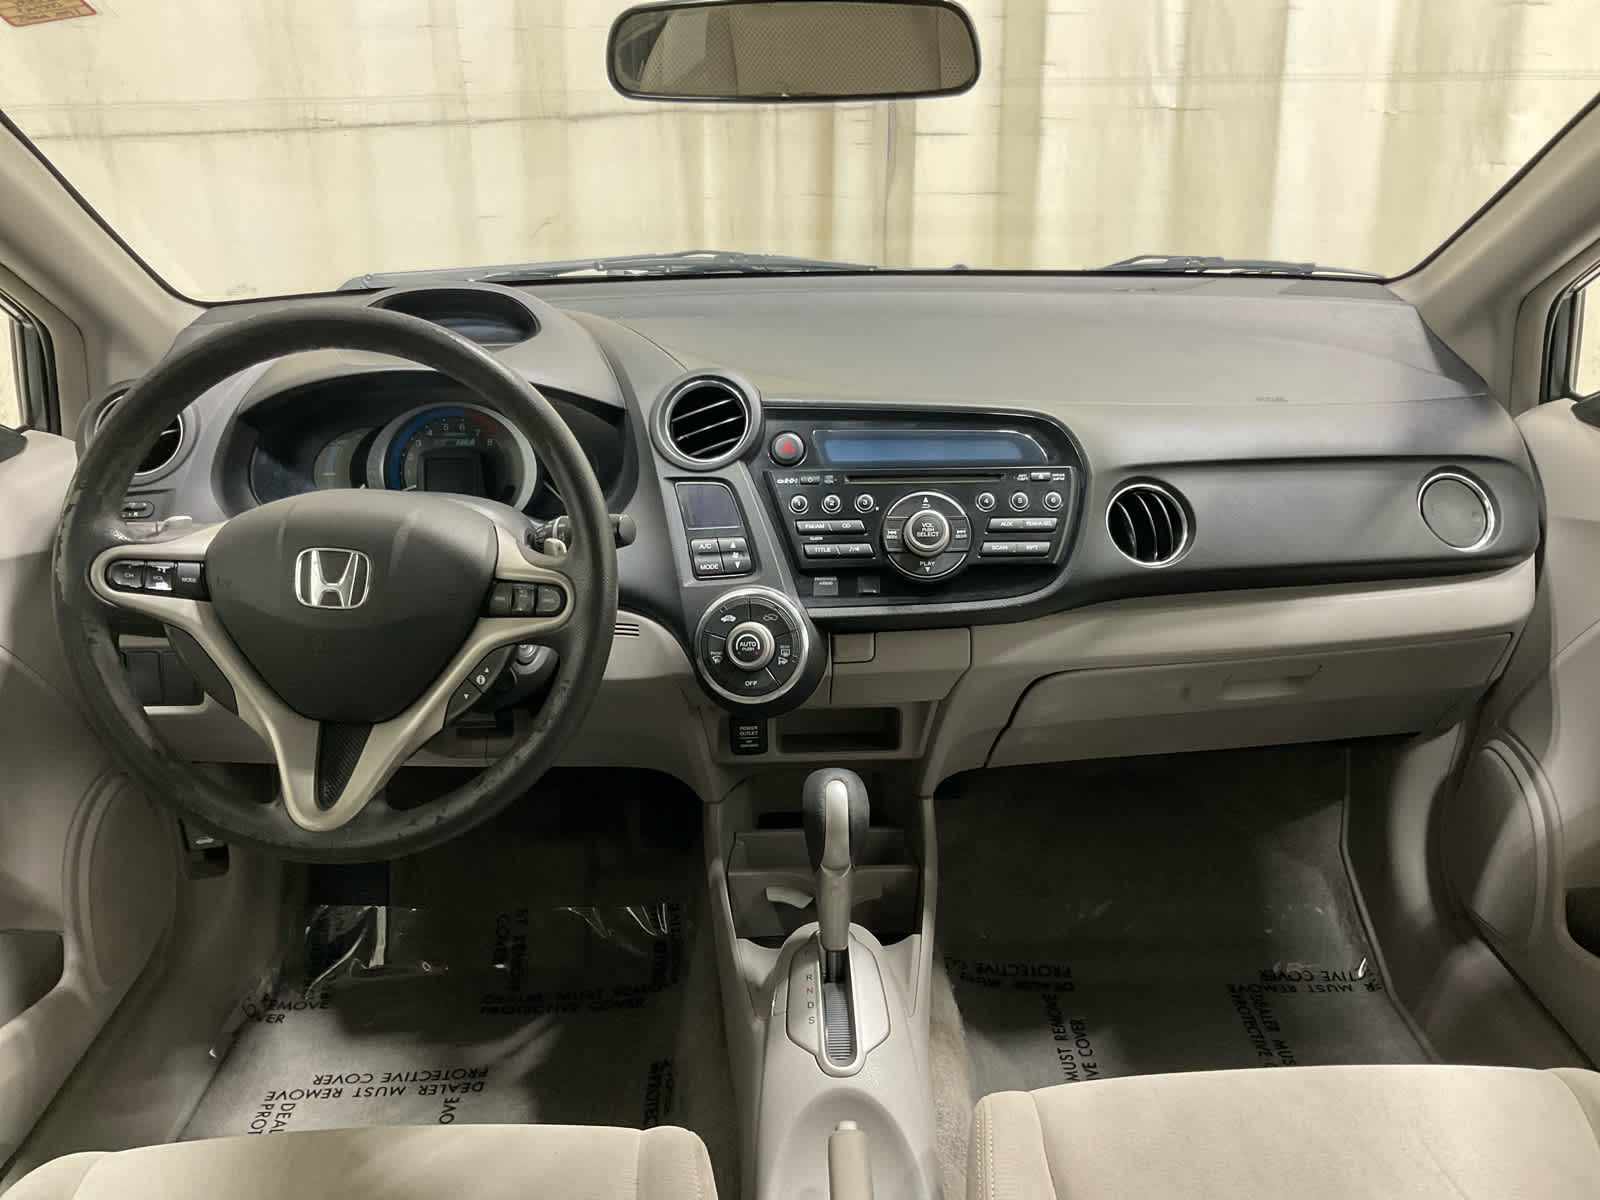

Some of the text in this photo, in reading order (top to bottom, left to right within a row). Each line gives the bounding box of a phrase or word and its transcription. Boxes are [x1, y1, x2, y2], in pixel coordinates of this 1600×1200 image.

[1258, 969, 1314, 982] COVER
[1308, 983, 1353, 993] MUST
[807, 1001, 815, 1009] D
[808, 1016, 816, 1025] S
[1070, 1019, 1094, 1057] COVER
[1057, 1048, 1080, 1081] MUST
[313, 1067, 489, 1086] PROTECTIVE COVER
[264, 1080, 485, 1101] DEALER MUST REMOVE
